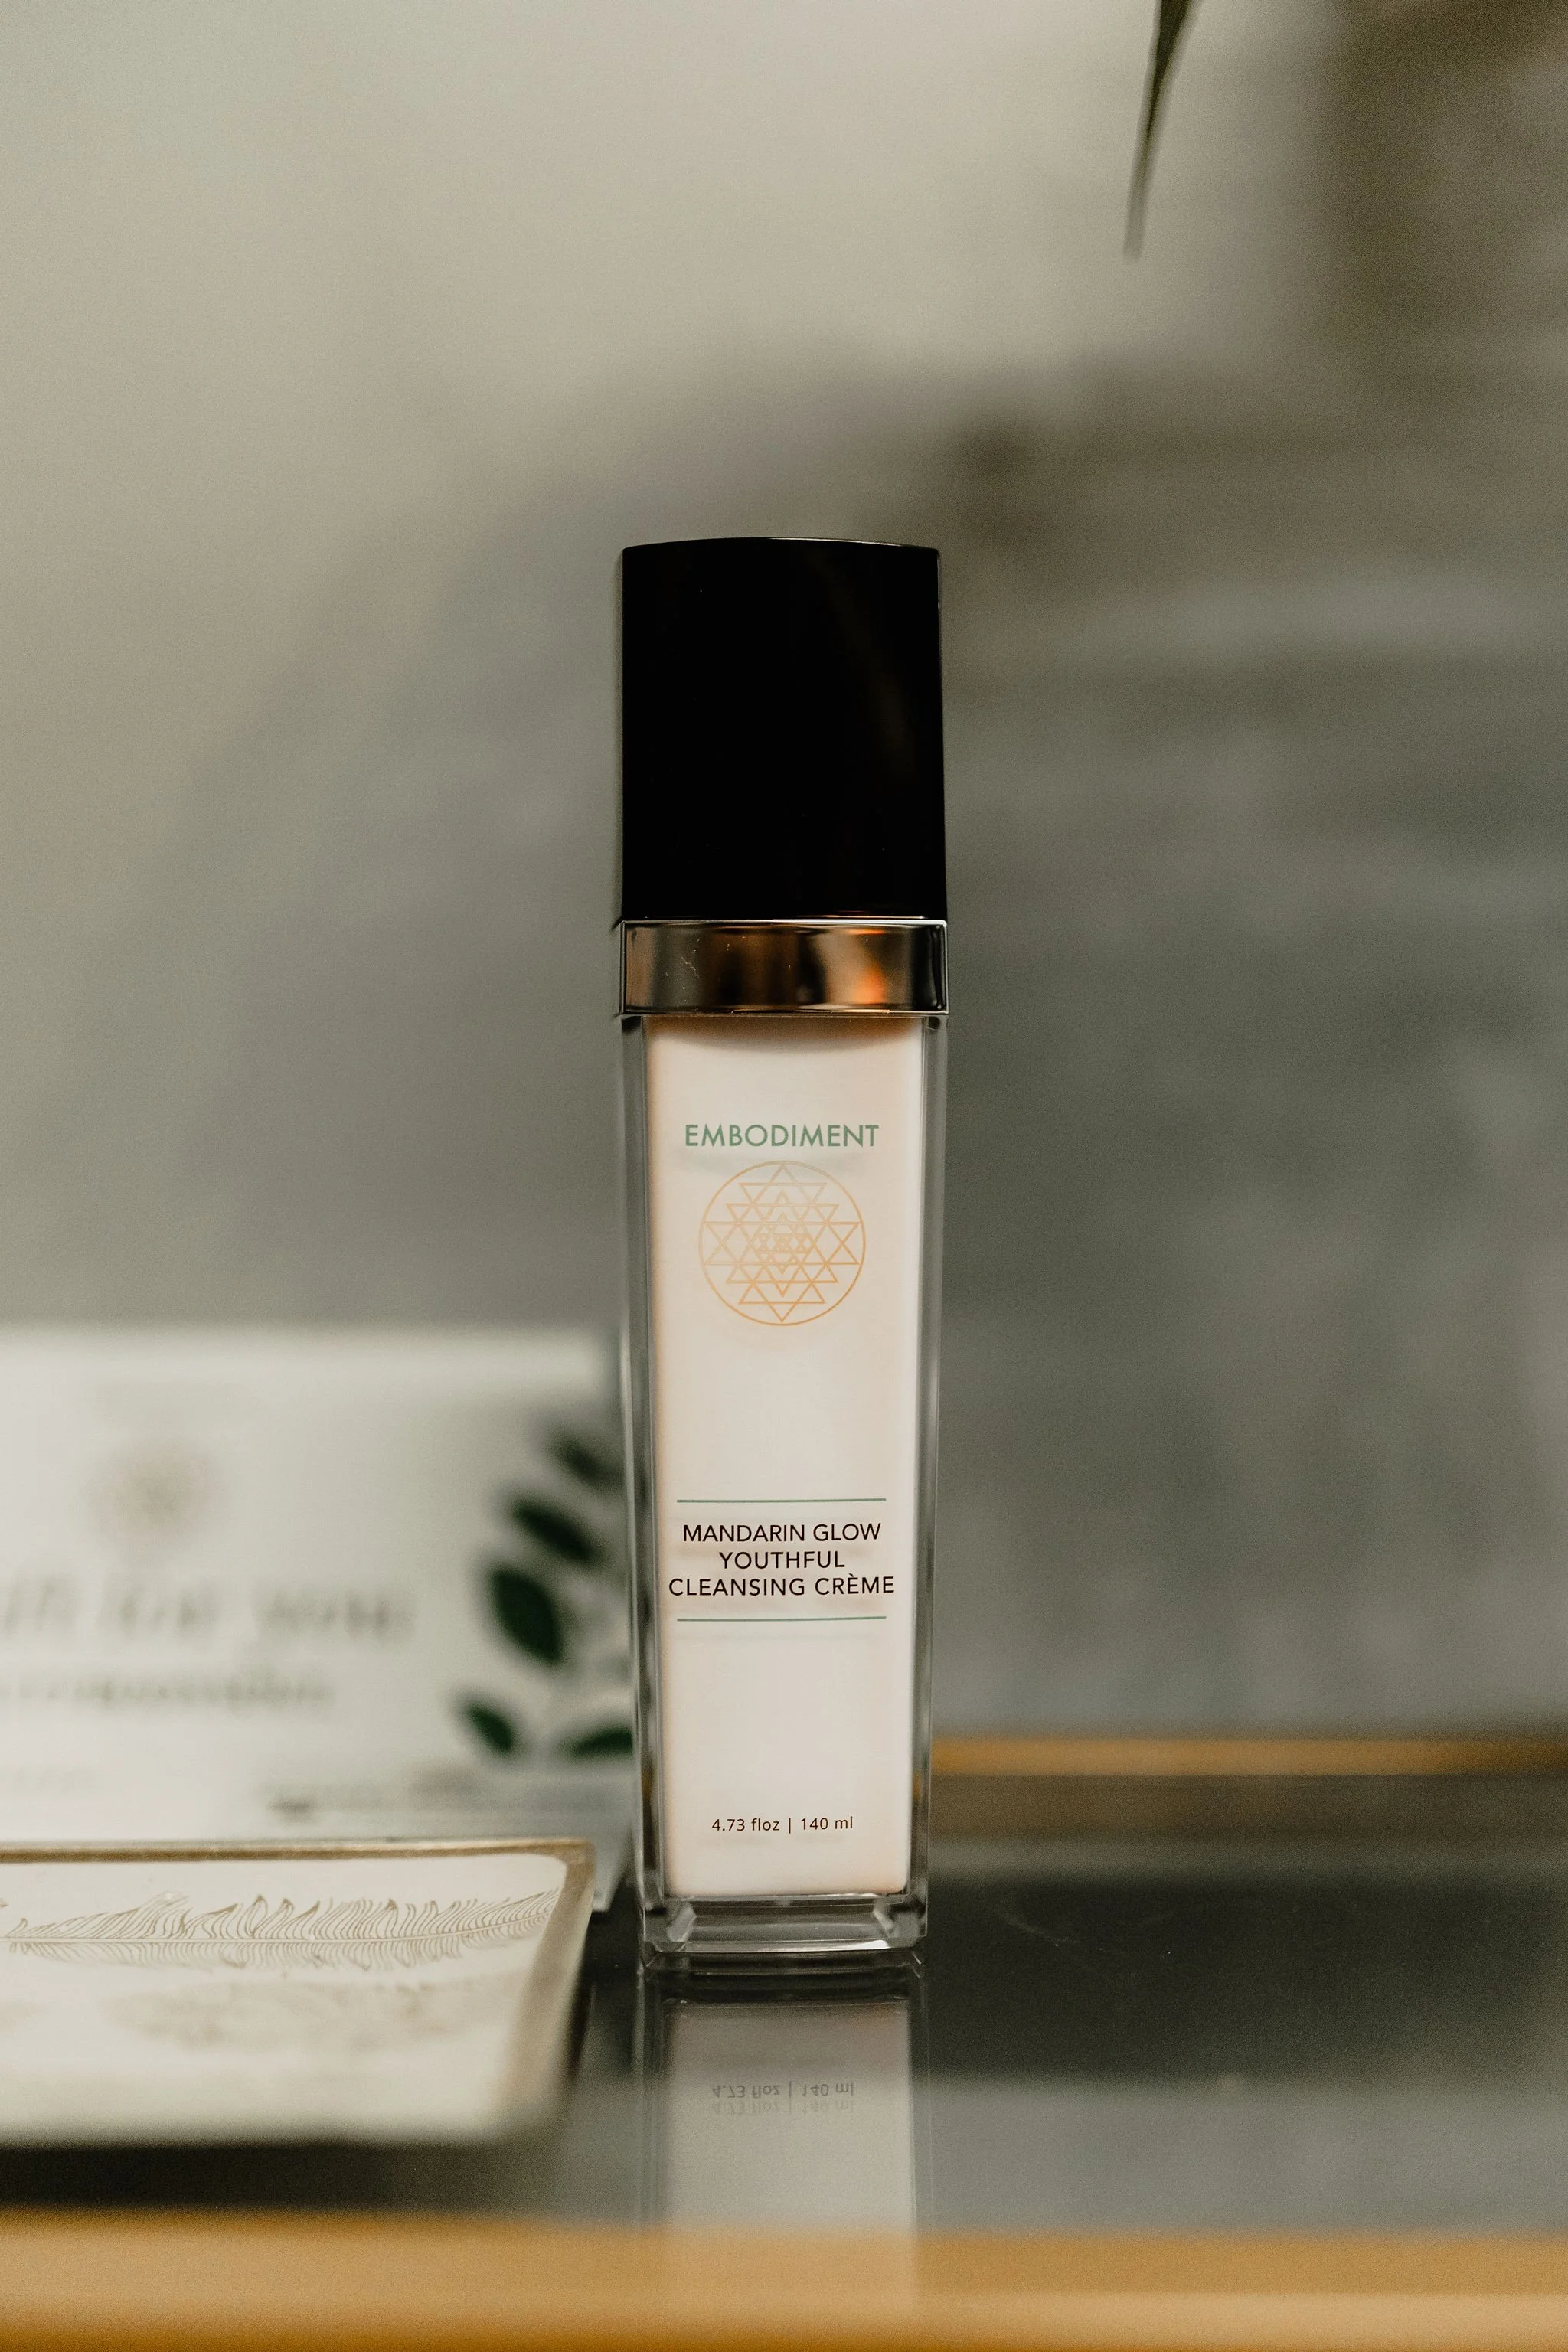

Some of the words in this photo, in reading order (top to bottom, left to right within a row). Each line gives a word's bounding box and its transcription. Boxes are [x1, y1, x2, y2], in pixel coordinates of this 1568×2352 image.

[685, 1124, 880, 1148] EMBODIMENT
[683, 1524, 805, 1542] MANDARIN
[812, 1522, 881, 1542] GLOW
[719, 1550, 845, 1570] YOUTHFUL
[668, 1578, 805, 1596] CLEANSING
[815, 1573, 894, 1596] CRÈME
[711, 1818, 746, 1831] 4.73
[801, 1817, 828, 1831] 140
[835, 1816, 854, 1830] ml
